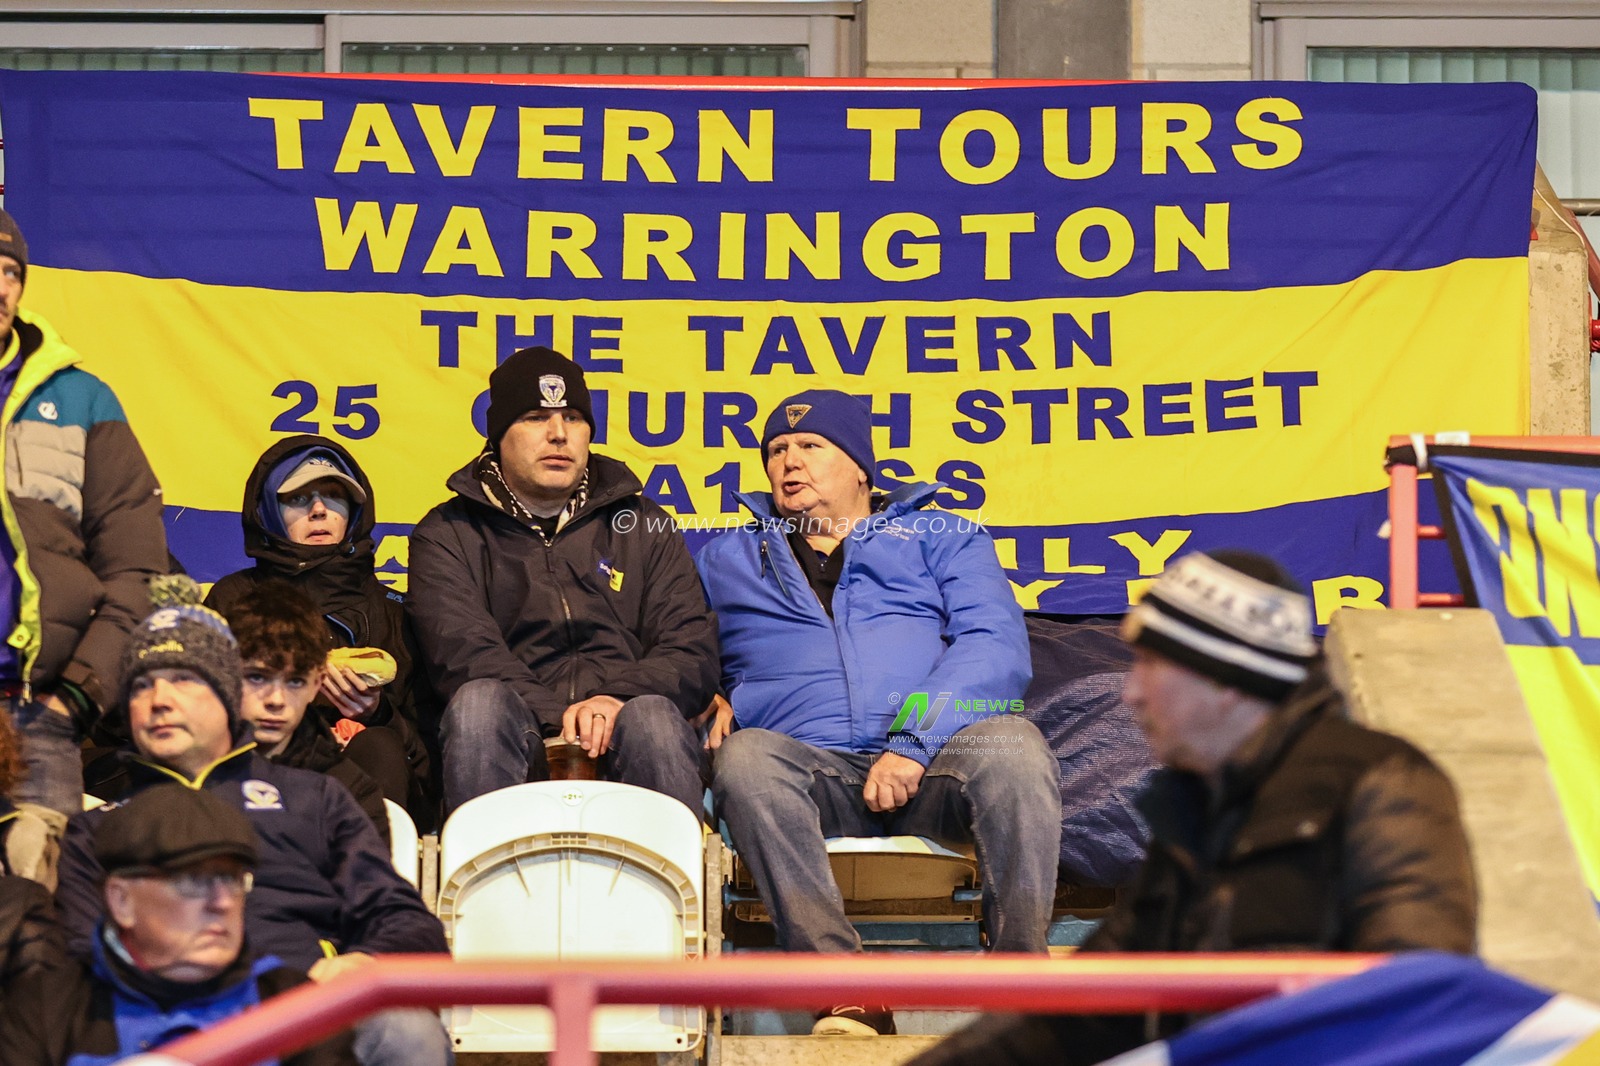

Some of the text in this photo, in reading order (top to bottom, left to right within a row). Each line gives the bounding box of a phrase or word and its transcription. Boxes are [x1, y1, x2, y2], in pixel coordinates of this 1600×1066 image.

[248, 97, 1303, 185] TAVERN TOURS
[314, 197, 1231, 282] WARRINGTON
[421, 310, 1112, 375] THE TAVERN
[270, 371, 1319, 448] 25 URH STREET
